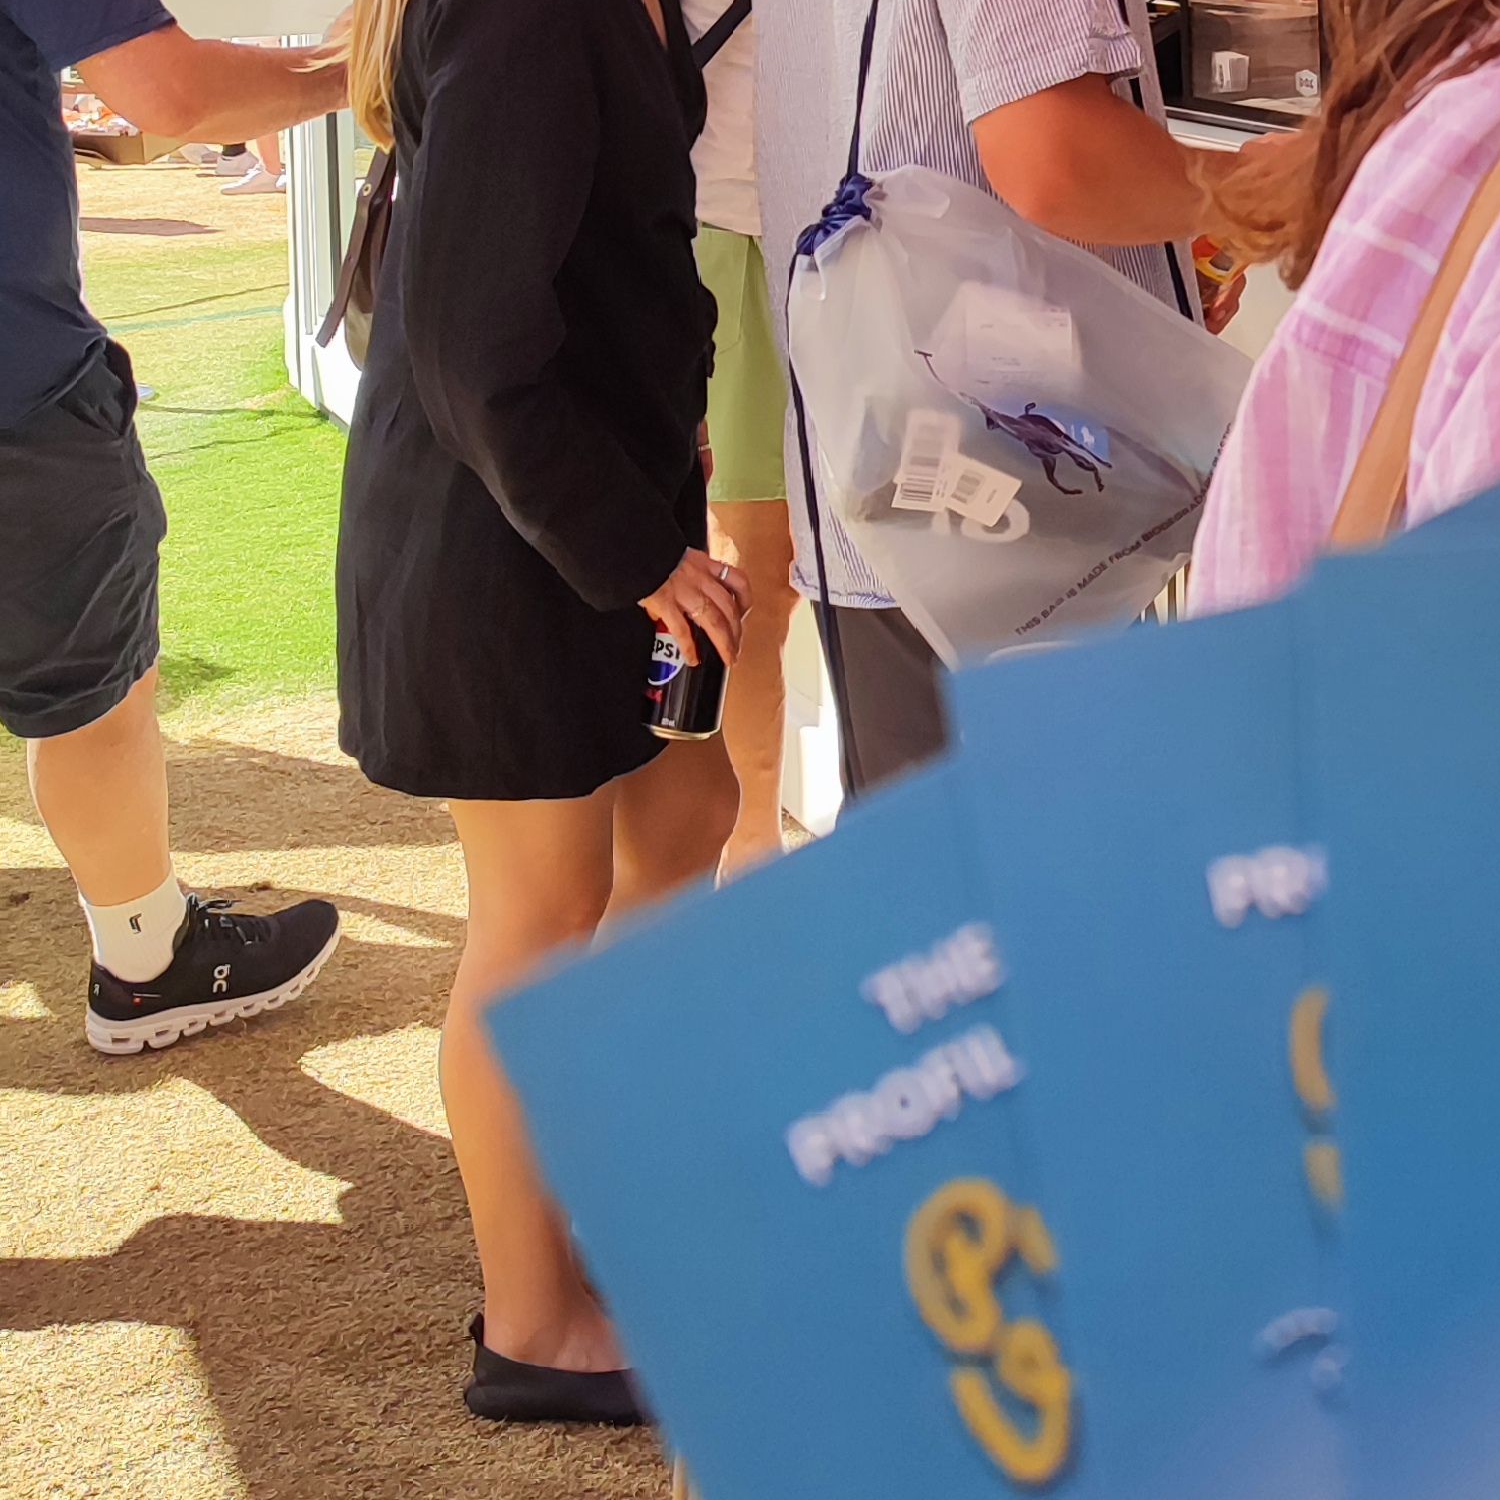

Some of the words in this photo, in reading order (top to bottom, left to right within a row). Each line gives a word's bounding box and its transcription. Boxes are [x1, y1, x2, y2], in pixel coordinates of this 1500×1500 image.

[1077, 562, 1108, 590] MADE
[1109, 541, 1142, 564] FROM
[655, 639, 680, 660] PSI
